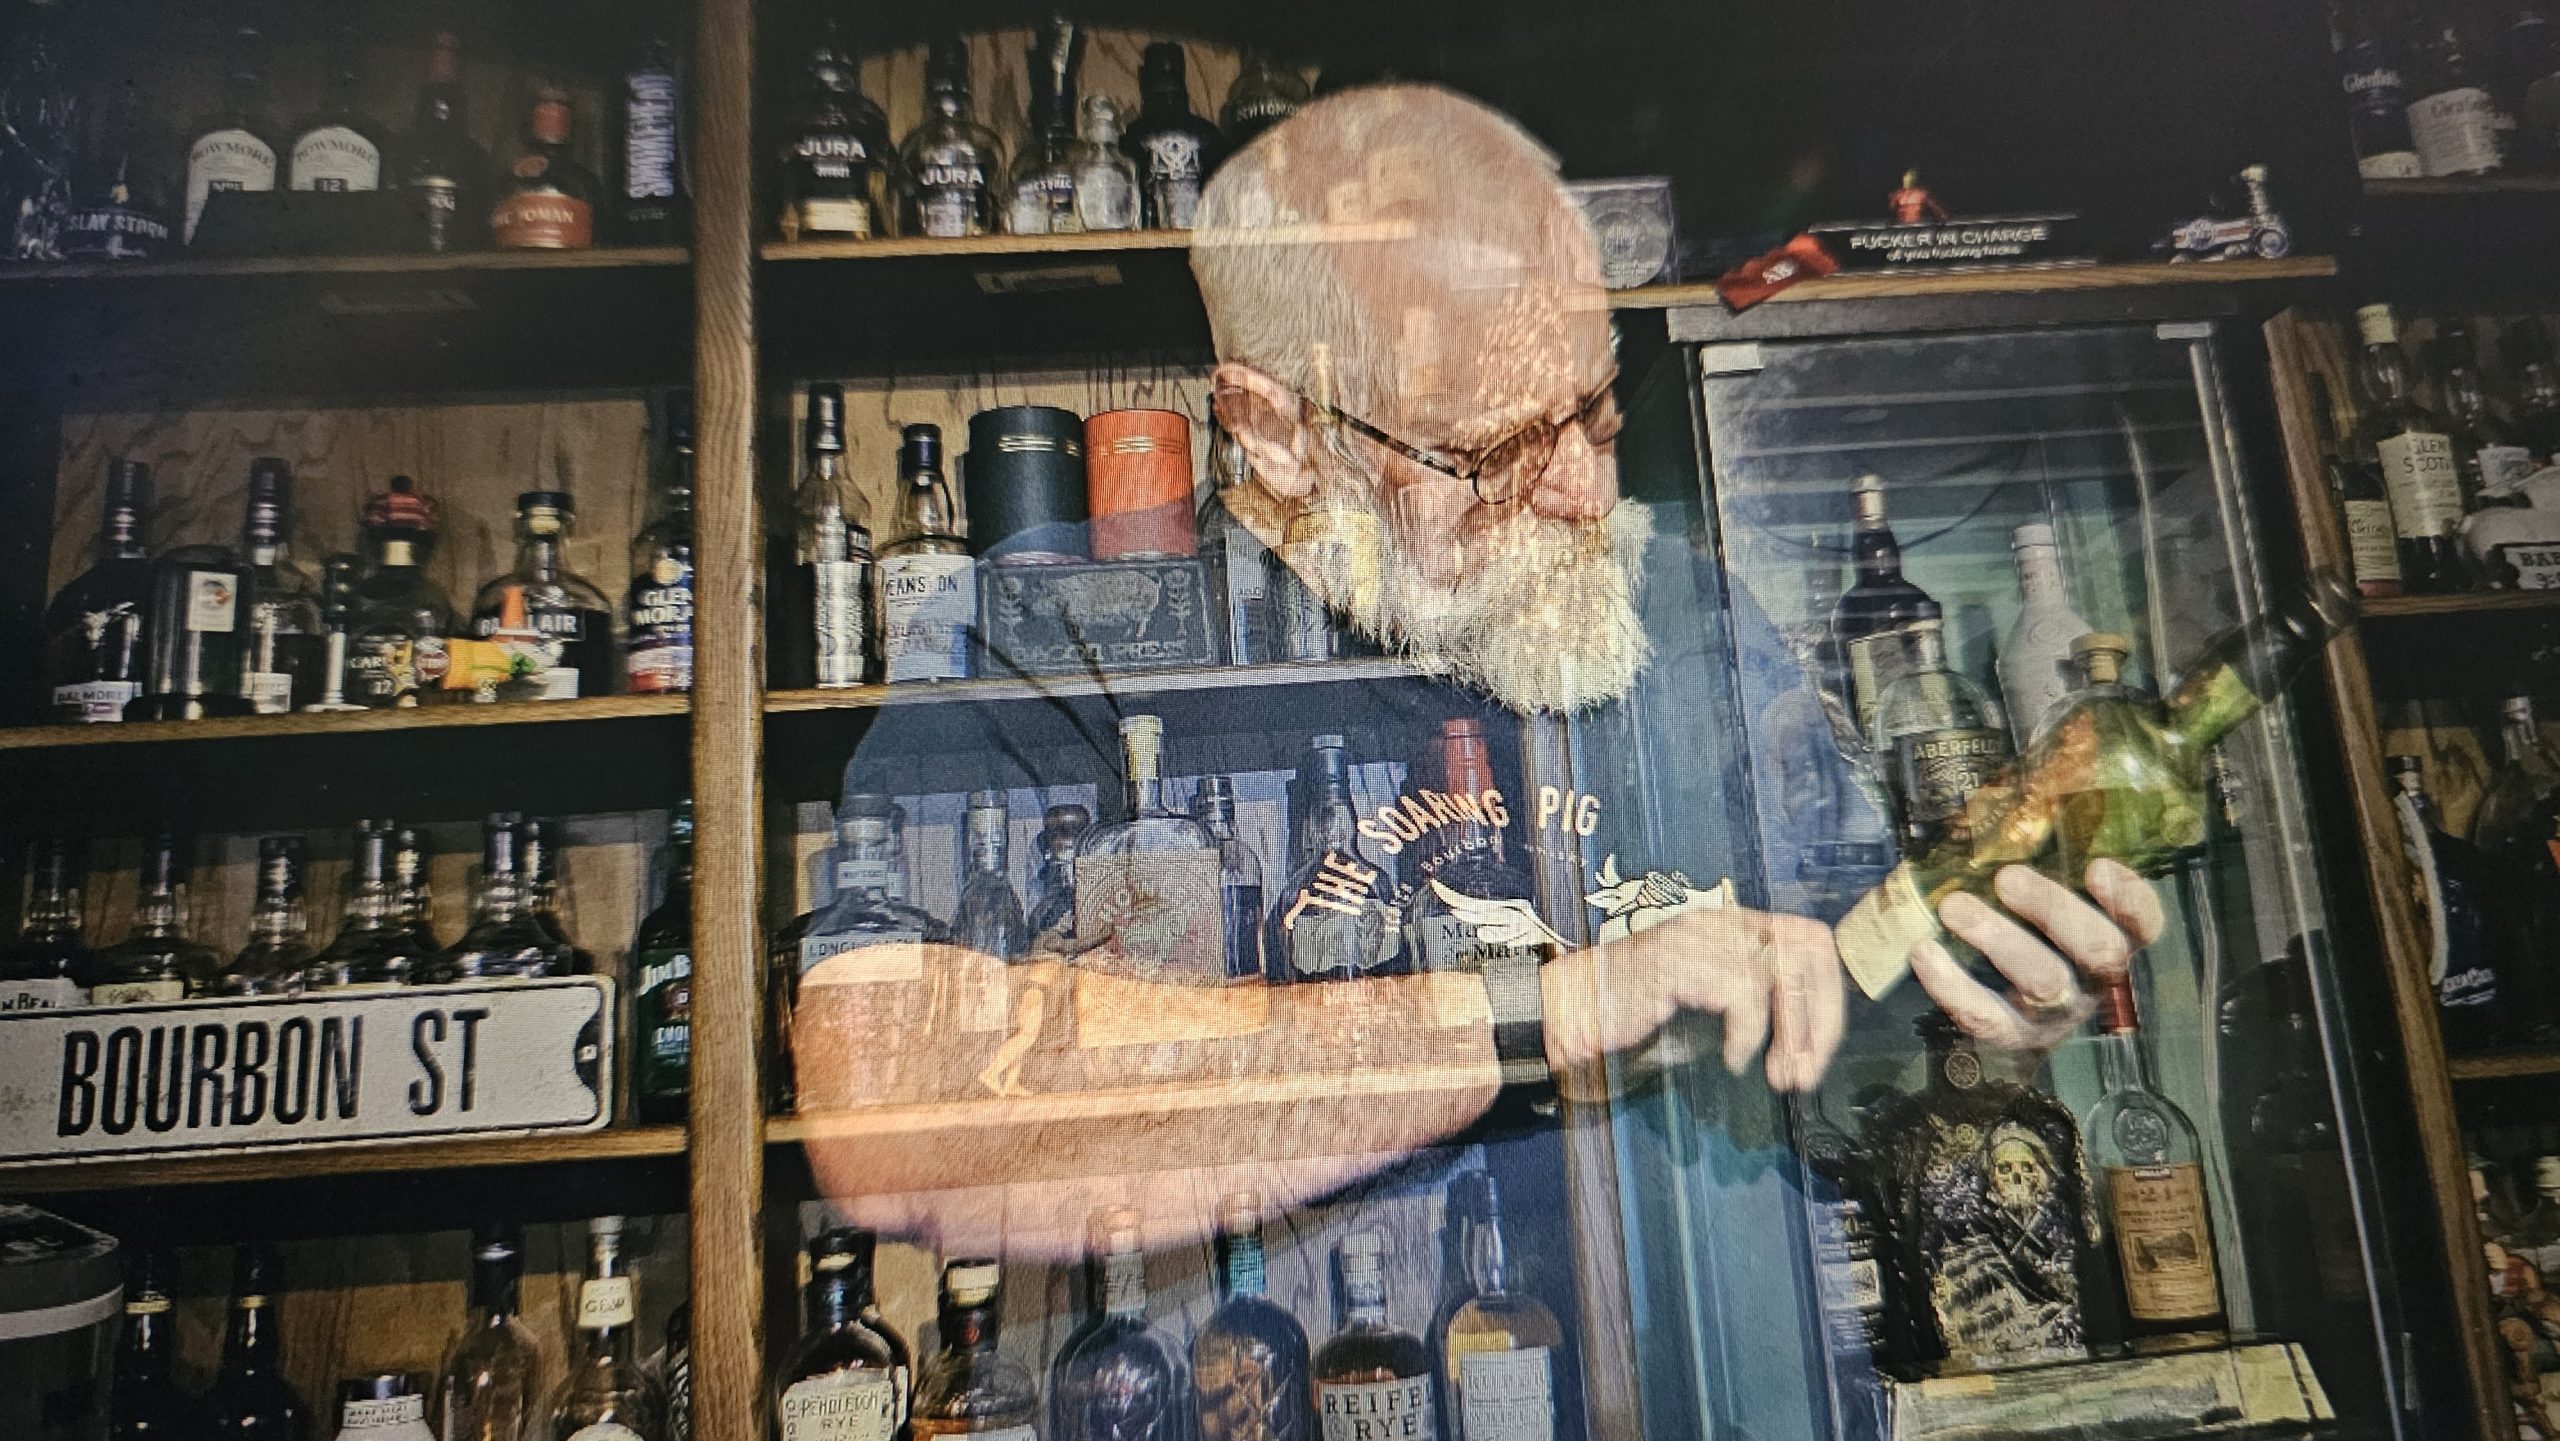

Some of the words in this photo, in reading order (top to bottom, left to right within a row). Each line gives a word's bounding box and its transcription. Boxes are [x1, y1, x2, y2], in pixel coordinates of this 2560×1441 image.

[191, 141, 274, 170] BOWMORE
[295, 139, 377, 166] BOWMORE
[798, 137, 867, 160] JURA
[920, 163, 985, 186] JURA
[1850, 231, 1933, 250] FUCKER
[1936, 229, 1957, 247] IN
[1961, 226, 2049, 245] CHARGE
[479, 614, 577, 638] BALAIR
[1283, 850, 1379, 930] THE
[1356, 788, 1511, 855] SOARING
[1537, 784, 1601, 838] PIG
[57, 1014, 364, 1138] BOURBON
[408, 1007, 491, 1116] ST
[800, 1390, 878, 1419] PENDLETON
[821, 1416, 859, 1431] RYE
[1353, 1412, 1419, 1440] RYE
